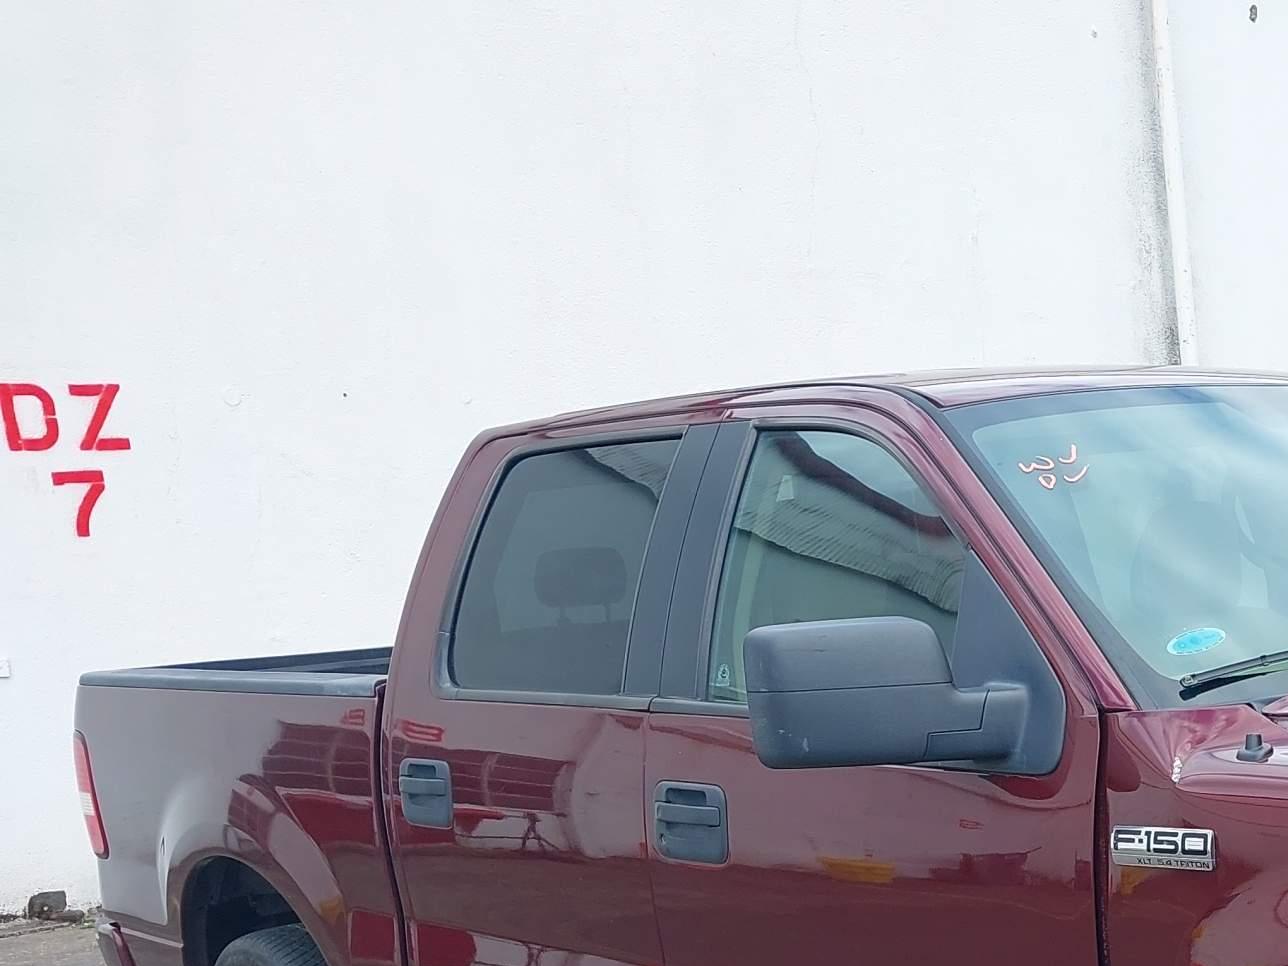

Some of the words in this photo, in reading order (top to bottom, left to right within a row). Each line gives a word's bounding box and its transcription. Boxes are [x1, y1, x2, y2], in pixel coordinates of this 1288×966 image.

[0, 383, 131, 452] DZ
[51, 469, 106, 539] 7
[1136, 857, 1152, 865] XLT
